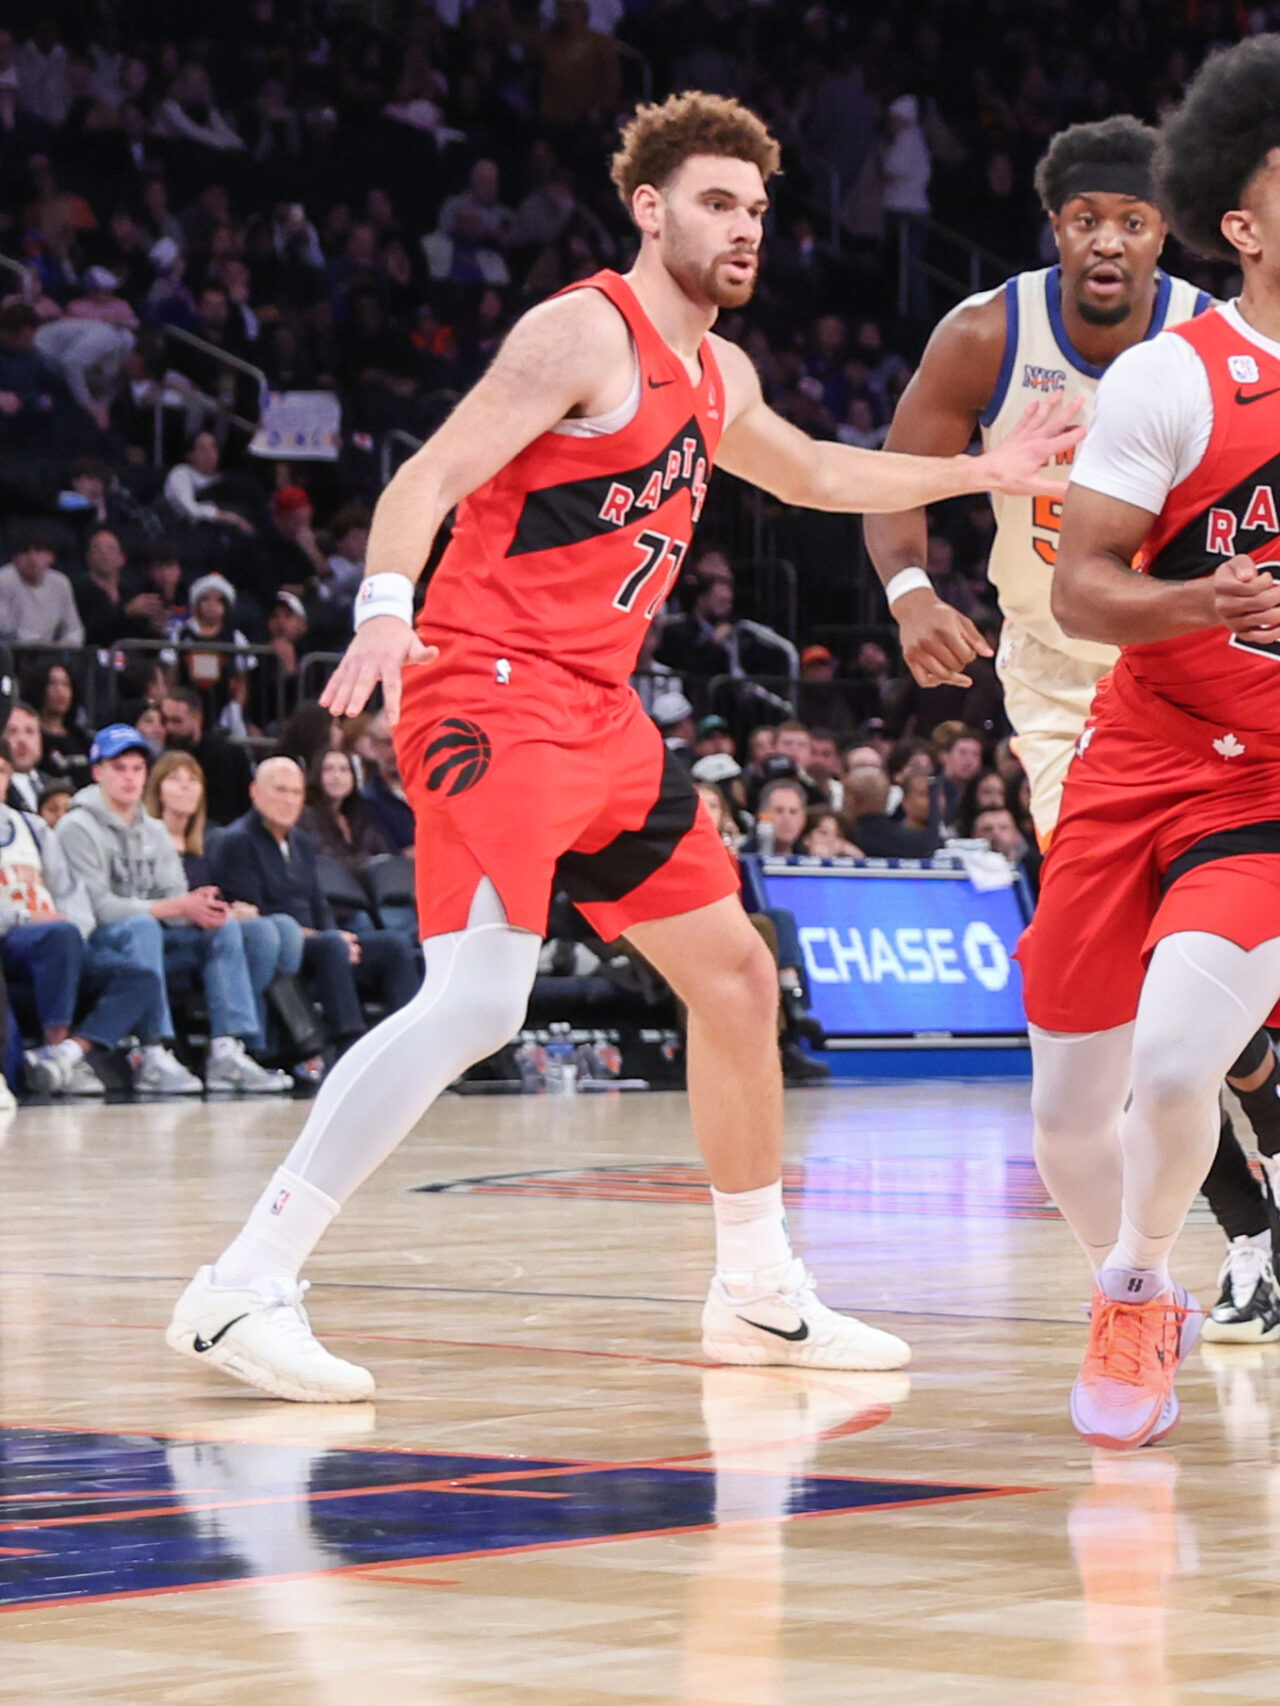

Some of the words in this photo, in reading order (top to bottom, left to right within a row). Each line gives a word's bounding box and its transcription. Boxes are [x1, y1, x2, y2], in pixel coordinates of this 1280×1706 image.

[1022, 364, 1066, 393] NYC
[612, 529, 688, 620] 77
[798, 926, 967, 984] CHASE
